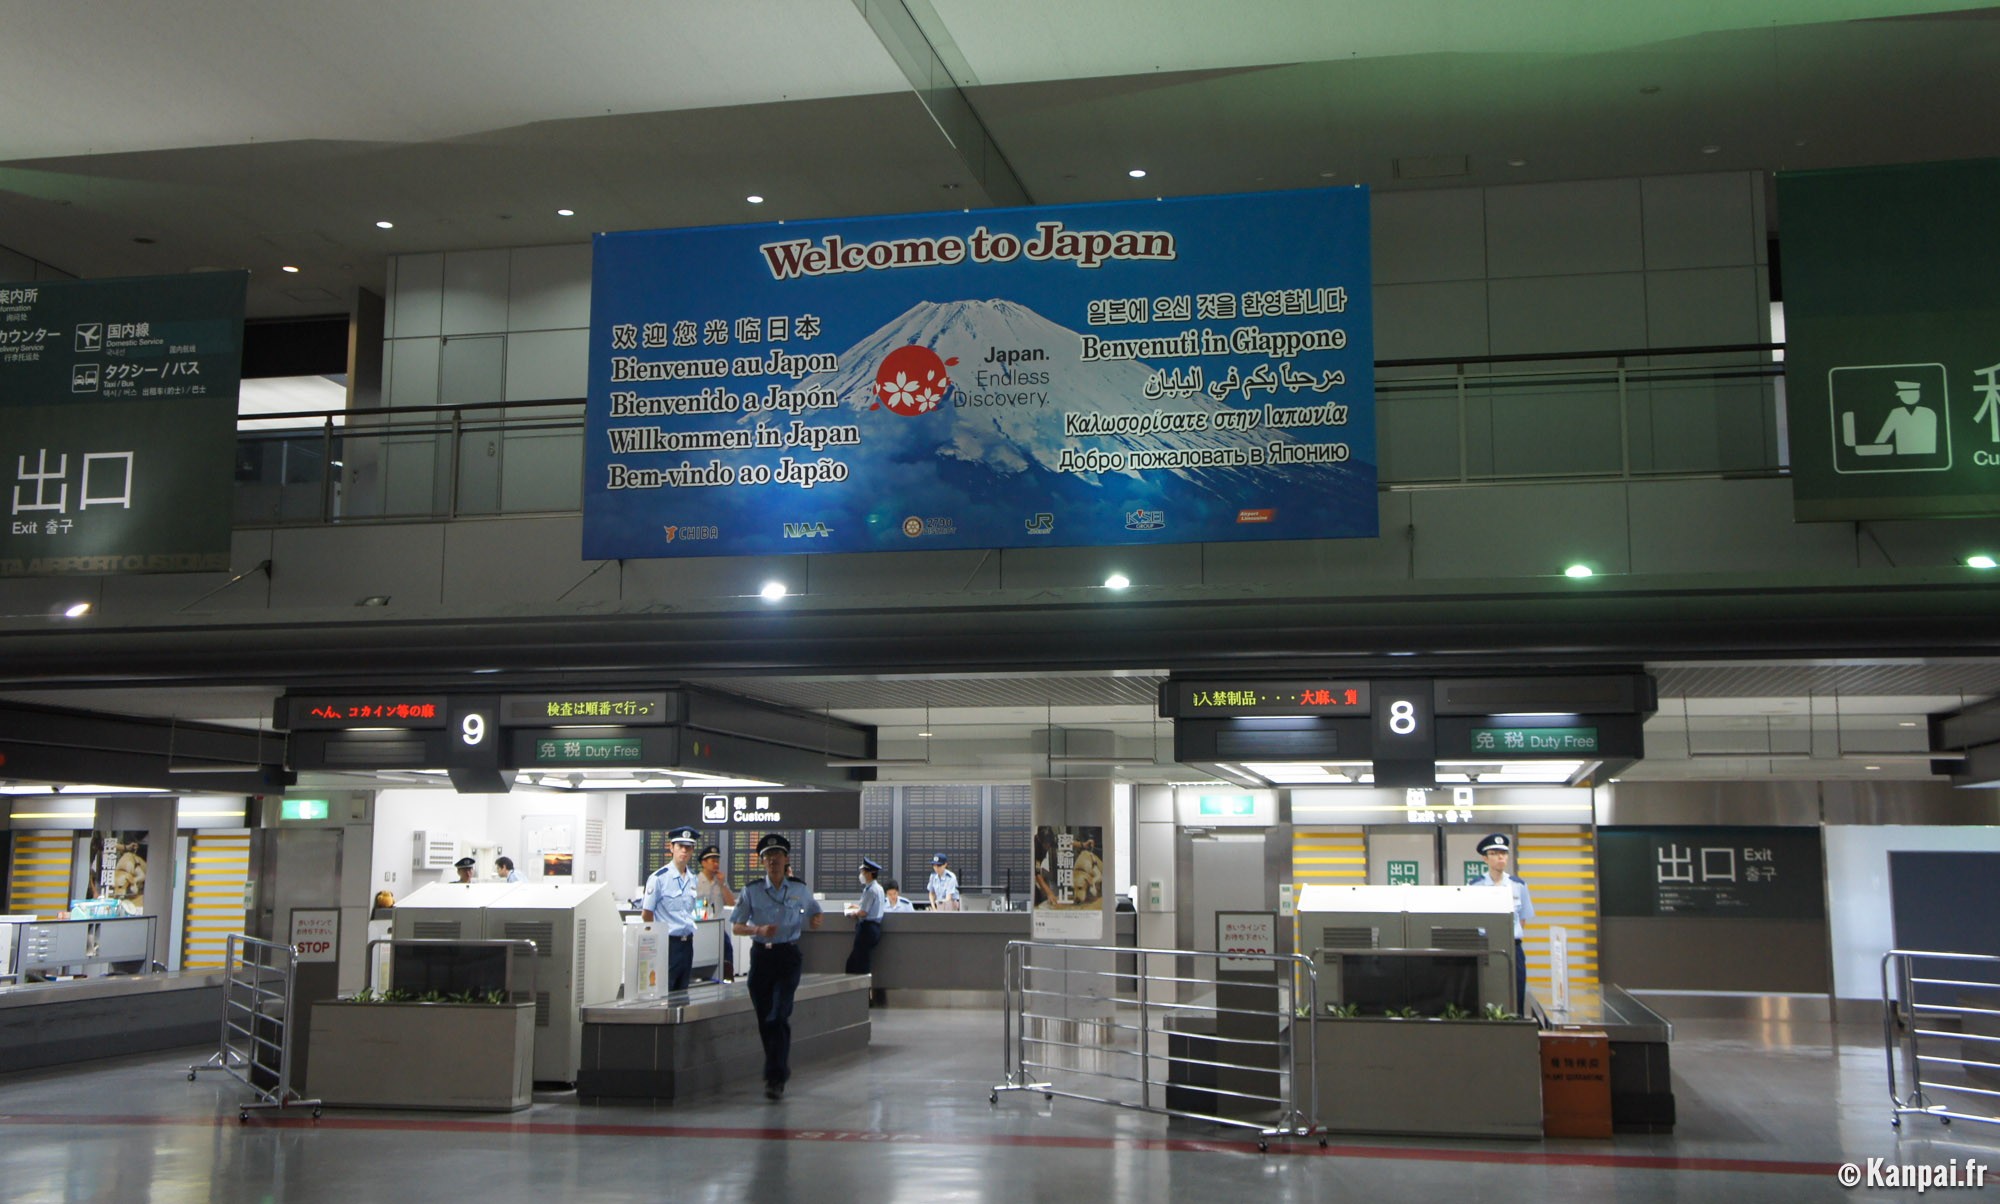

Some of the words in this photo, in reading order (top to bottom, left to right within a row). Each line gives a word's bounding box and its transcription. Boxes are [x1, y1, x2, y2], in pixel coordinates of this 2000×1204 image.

[762, 235, 966, 280] Welcome
[971, 227, 1020, 262] to
[1026, 221, 1176, 268] Japan
[1087, 298, 1149, 325] 일본에
[1153, 295, 1191, 321] 오신
[1197, 292, 1236, 319] 것을
[1242, 286, 1347, 317] 환영합니다
[107, 322, 149, 339] 国内線
[612, 315, 820, 349] 欢迎您光临日本
[139, 338, 164, 346] Service
[1081, 330, 1199, 361] Benvenuti
[1202, 328, 1229, 355] in
[1232, 326, 1347, 359] Giappone
[611, 356, 728, 382] Bienvenue
[732, 357, 764, 375] au
[766, 349, 838, 380] Japon
[984, 347, 1050, 366] Japan.
[105, 364, 158, 379] タクシー
[172, 361, 200, 375] バス
[976, 369, 1050, 387] Endless
[1143, 366, 1203, 399] اليابان
[1209, 366, 1240, 399] في
[1242, 363, 1279, 400] بكم
[610, 390, 739, 417] Bienvenido
[742, 393, 759, 411] a
[763, 383, 838, 414] Japón
[953, 391, 1050, 408] Discovery.
[1064, 411, 1208, 437] Καλωσορίσατε
[1213, 409, 1260, 431] στην
[1263, 404, 1347, 427] Ιαπωνία
[608, 426, 751, 453] Willkommen
[756, 423, 781, 447] in
[785, 421, 860, 451] Japan
[1058, 448, 1124, 474] Добро
[1128, 446, 1245, 469] пожаловать
[1249, 449, 1262, 465] в
[1268, 441, 1349, 466] Японию
[1973, 450, 2000, 466] Cu
[12, 449, 134, 515] 出口
[608, 461, 734, 489] Bem-vindo
[739, 466, 769, 485] ao
[775, 457, 848, 489] Japão
[12, 521, 37, 534] Exit
[45, 519, 73, 534] 출구
[927, 517, 953, 528] 2790
[1025, 512, 1054, 529] JR
[679, 526, 718, 540] CHIBA
[783, 522, 834, 538] NAA
[547, 701, 655, 717] 検査は順番で行っ
[1389, 700, 1415, 734] 8
[462, 713, 484, 745] 9
[585, 745, 610, 758] Duty
[613, 745, 639, 757] Free
[1530, 736, 1560, 750] Duty
[1564, 736, 1595, 747] Free
[733, 810, 780, 822] Customs
[1657, 843, 1737, 883] 出口
[1743, 848, 1772, 861] Exit
[1057, 833, 1074, 904] 密輸阻止
[1390, 863, 1415, 876] 出口
[1745, 866, 1777, 882] 출구
[297, 941, 330, 953] STOP
